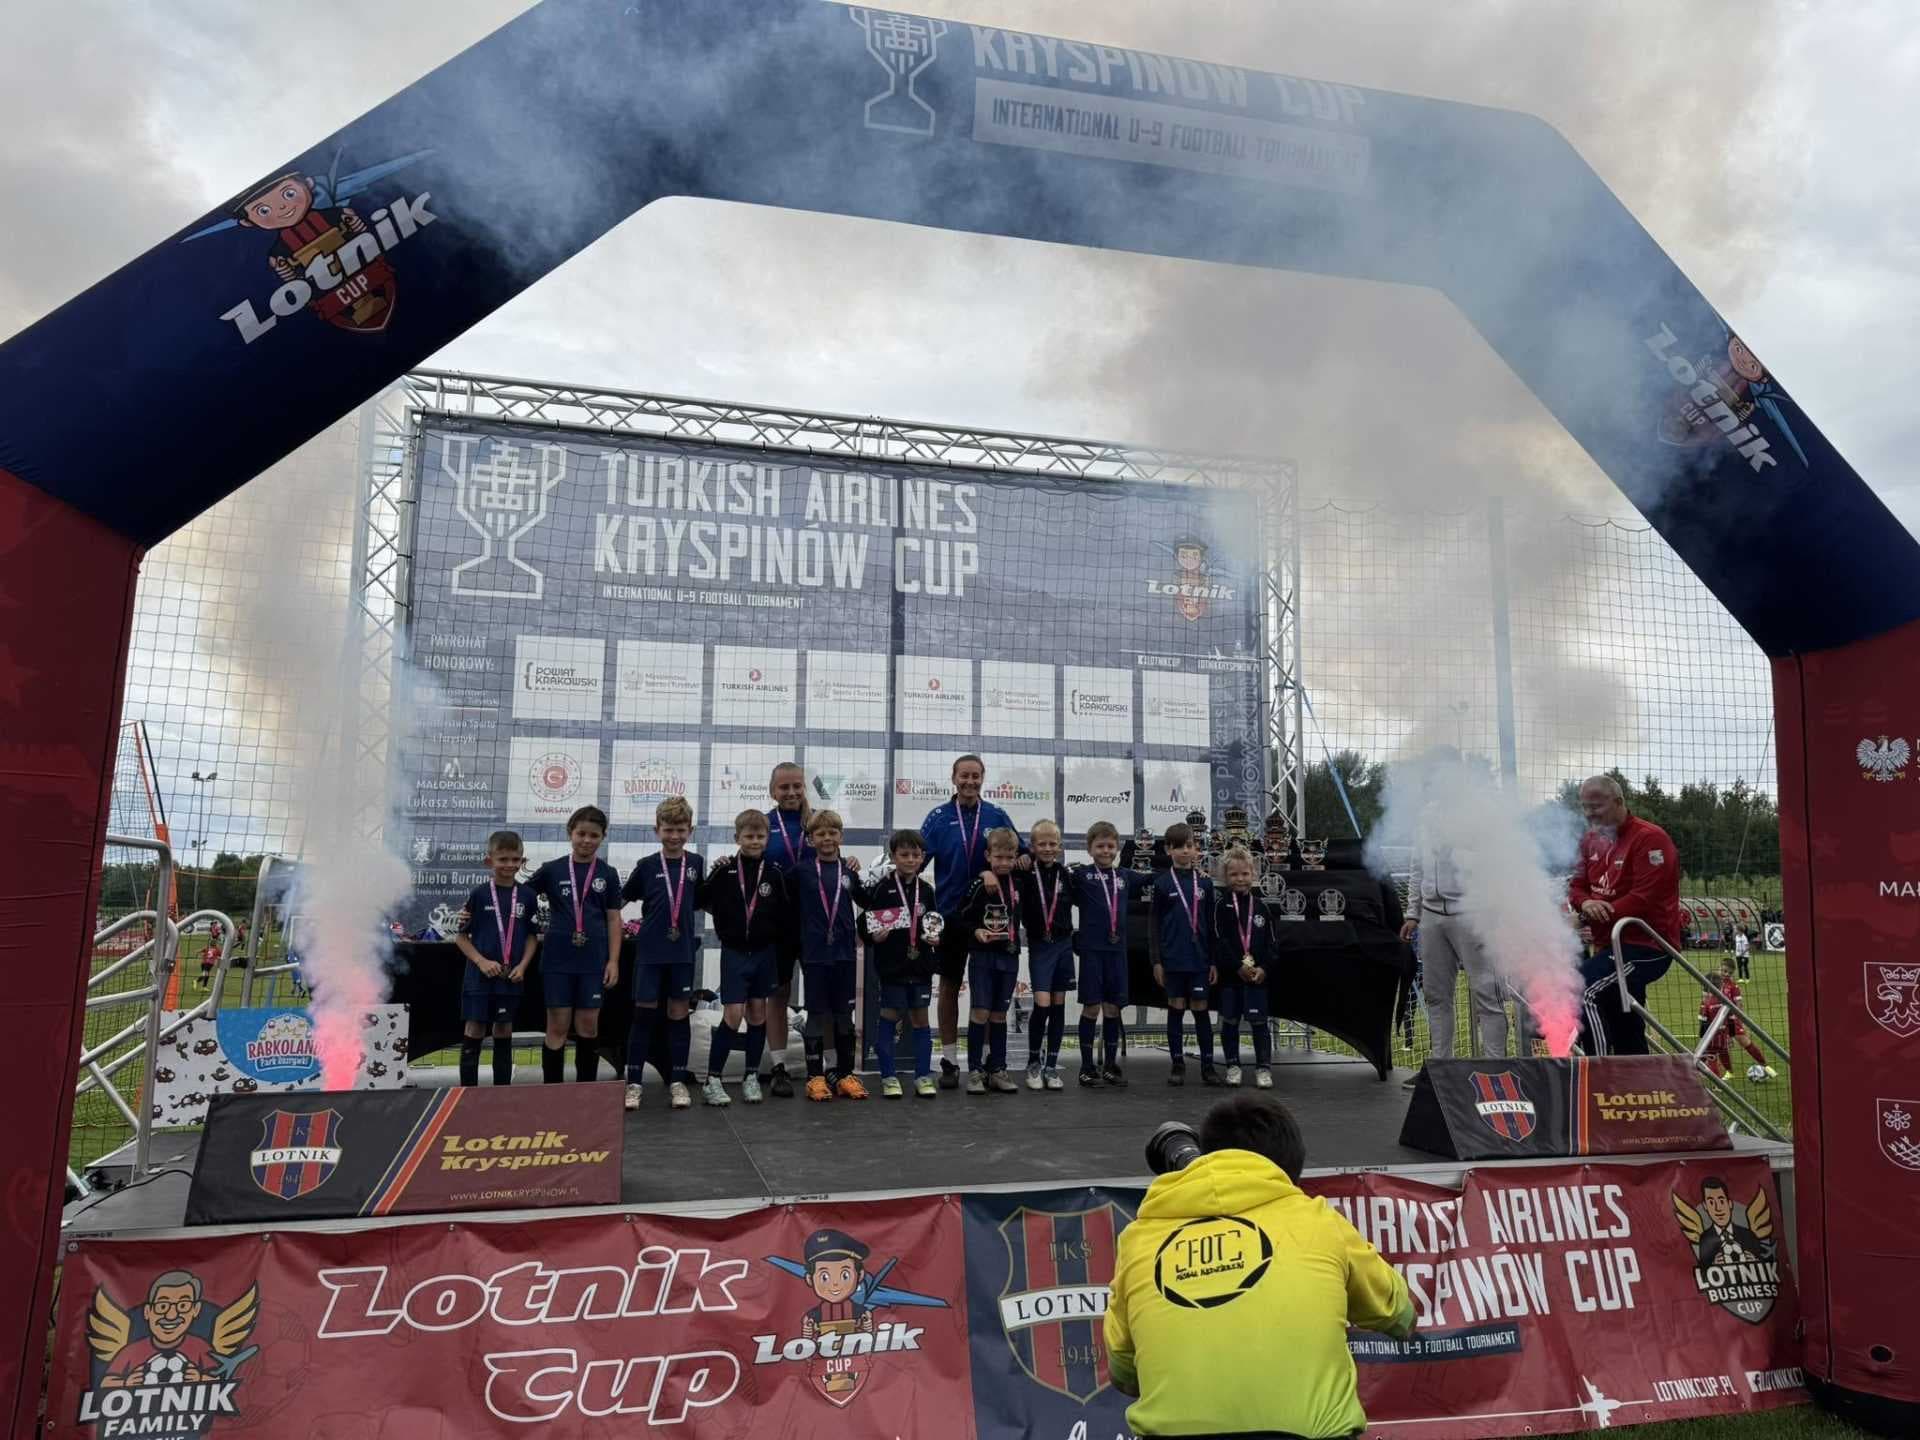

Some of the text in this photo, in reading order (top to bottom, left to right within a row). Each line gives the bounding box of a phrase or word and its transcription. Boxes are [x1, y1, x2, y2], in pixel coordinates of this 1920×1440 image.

[1275, 74, 1365, 123] CUP
[992, 98, 1120, 141] INTERNATIONAL
[1129, 120, 1163, 147] U-9
[1170, 124, 1247, 160] FOOTBALL
[219, 191, 437, 344] Lotnik
[336, 273, 369, 305] CUP
[1644, 321, 1777, 472] Lotnik
[1680, 402, 1706, 426] CUP
[602, 452, 977, 534] TURKISH AIRLINES
[594, 513, 979, 597] KRYSPINÓW CUP
[602, 584, 804, 608] INTERNATIONAL U-9 FOOTBALL TOURNAMENT
[1144, 579, 1235, 600] Lotnik
[430, 634, 487, 649] PATRONAT
[424, 655, 495, 671] HONOROWY:
[535, 667, 576, 677] POWIAT
[535, 676, 598, 687] KRAKOWSKI
[721, 682, 788, 692] TURKISH AIRLINES
[904, 691, 934, 699] TURKISH
[1079, 694, 1110, 702] POWIAT
[1079, 702, 1128, 712] KRAKOWSKI
[624, 779, 686, 796] RABKOLAND
[912, 786, 949, 795] Garden
[1067, 793, 1121, 804] mplservices
[1151, 804, 1206, 813] MAŁOPOLSKA
[535, 806, 573, 814] WARSAW
[247, 1040, 320, 1058] RABKOLAN
[1483, 1103, 1529, 1112] LOTNIK
[1592, 1090, 1676, 1106] Lotnik
[1600, 1104, 1710, 1122] Kryspinów
[442, 1131, 569, 1152] Lotnik
[262, 1150, 331, 1162] LOTNIK
[440, 1149, 611, 1172] Kryspinów
[1482, 1184, 1632, 1246] AIRLINES
[1565, 1247, 1642, 1313] CUP
[1695, 1262, 1781, 1290] LOTNIK
[317, 1245, 749, 1339] Lotnik
[1708, 1284, 1778, 1303] BUSINESS
[1016, 1293, 1110, 1320] LOTNI
[1737, 1301, 1763, 1314] CUP
[751, 1321, 925, 1365] Lotnik
[1403, 1341, 1422, 1355] U-9
[1425, 1337, 1464, 1353] FOOTBALL
[1466, 1330, 1518, 1349] TOURNAMENT
[826, 1358, 853, 1373] CUP
[483, 1348, 741, 1426] Cup
[1652, 1375, 1738, 1402] LOTNIKCUP.PL
[79, 1382, 237, 1422] LOTNIK
[104, 1413, 207, 1438] FAMILY
